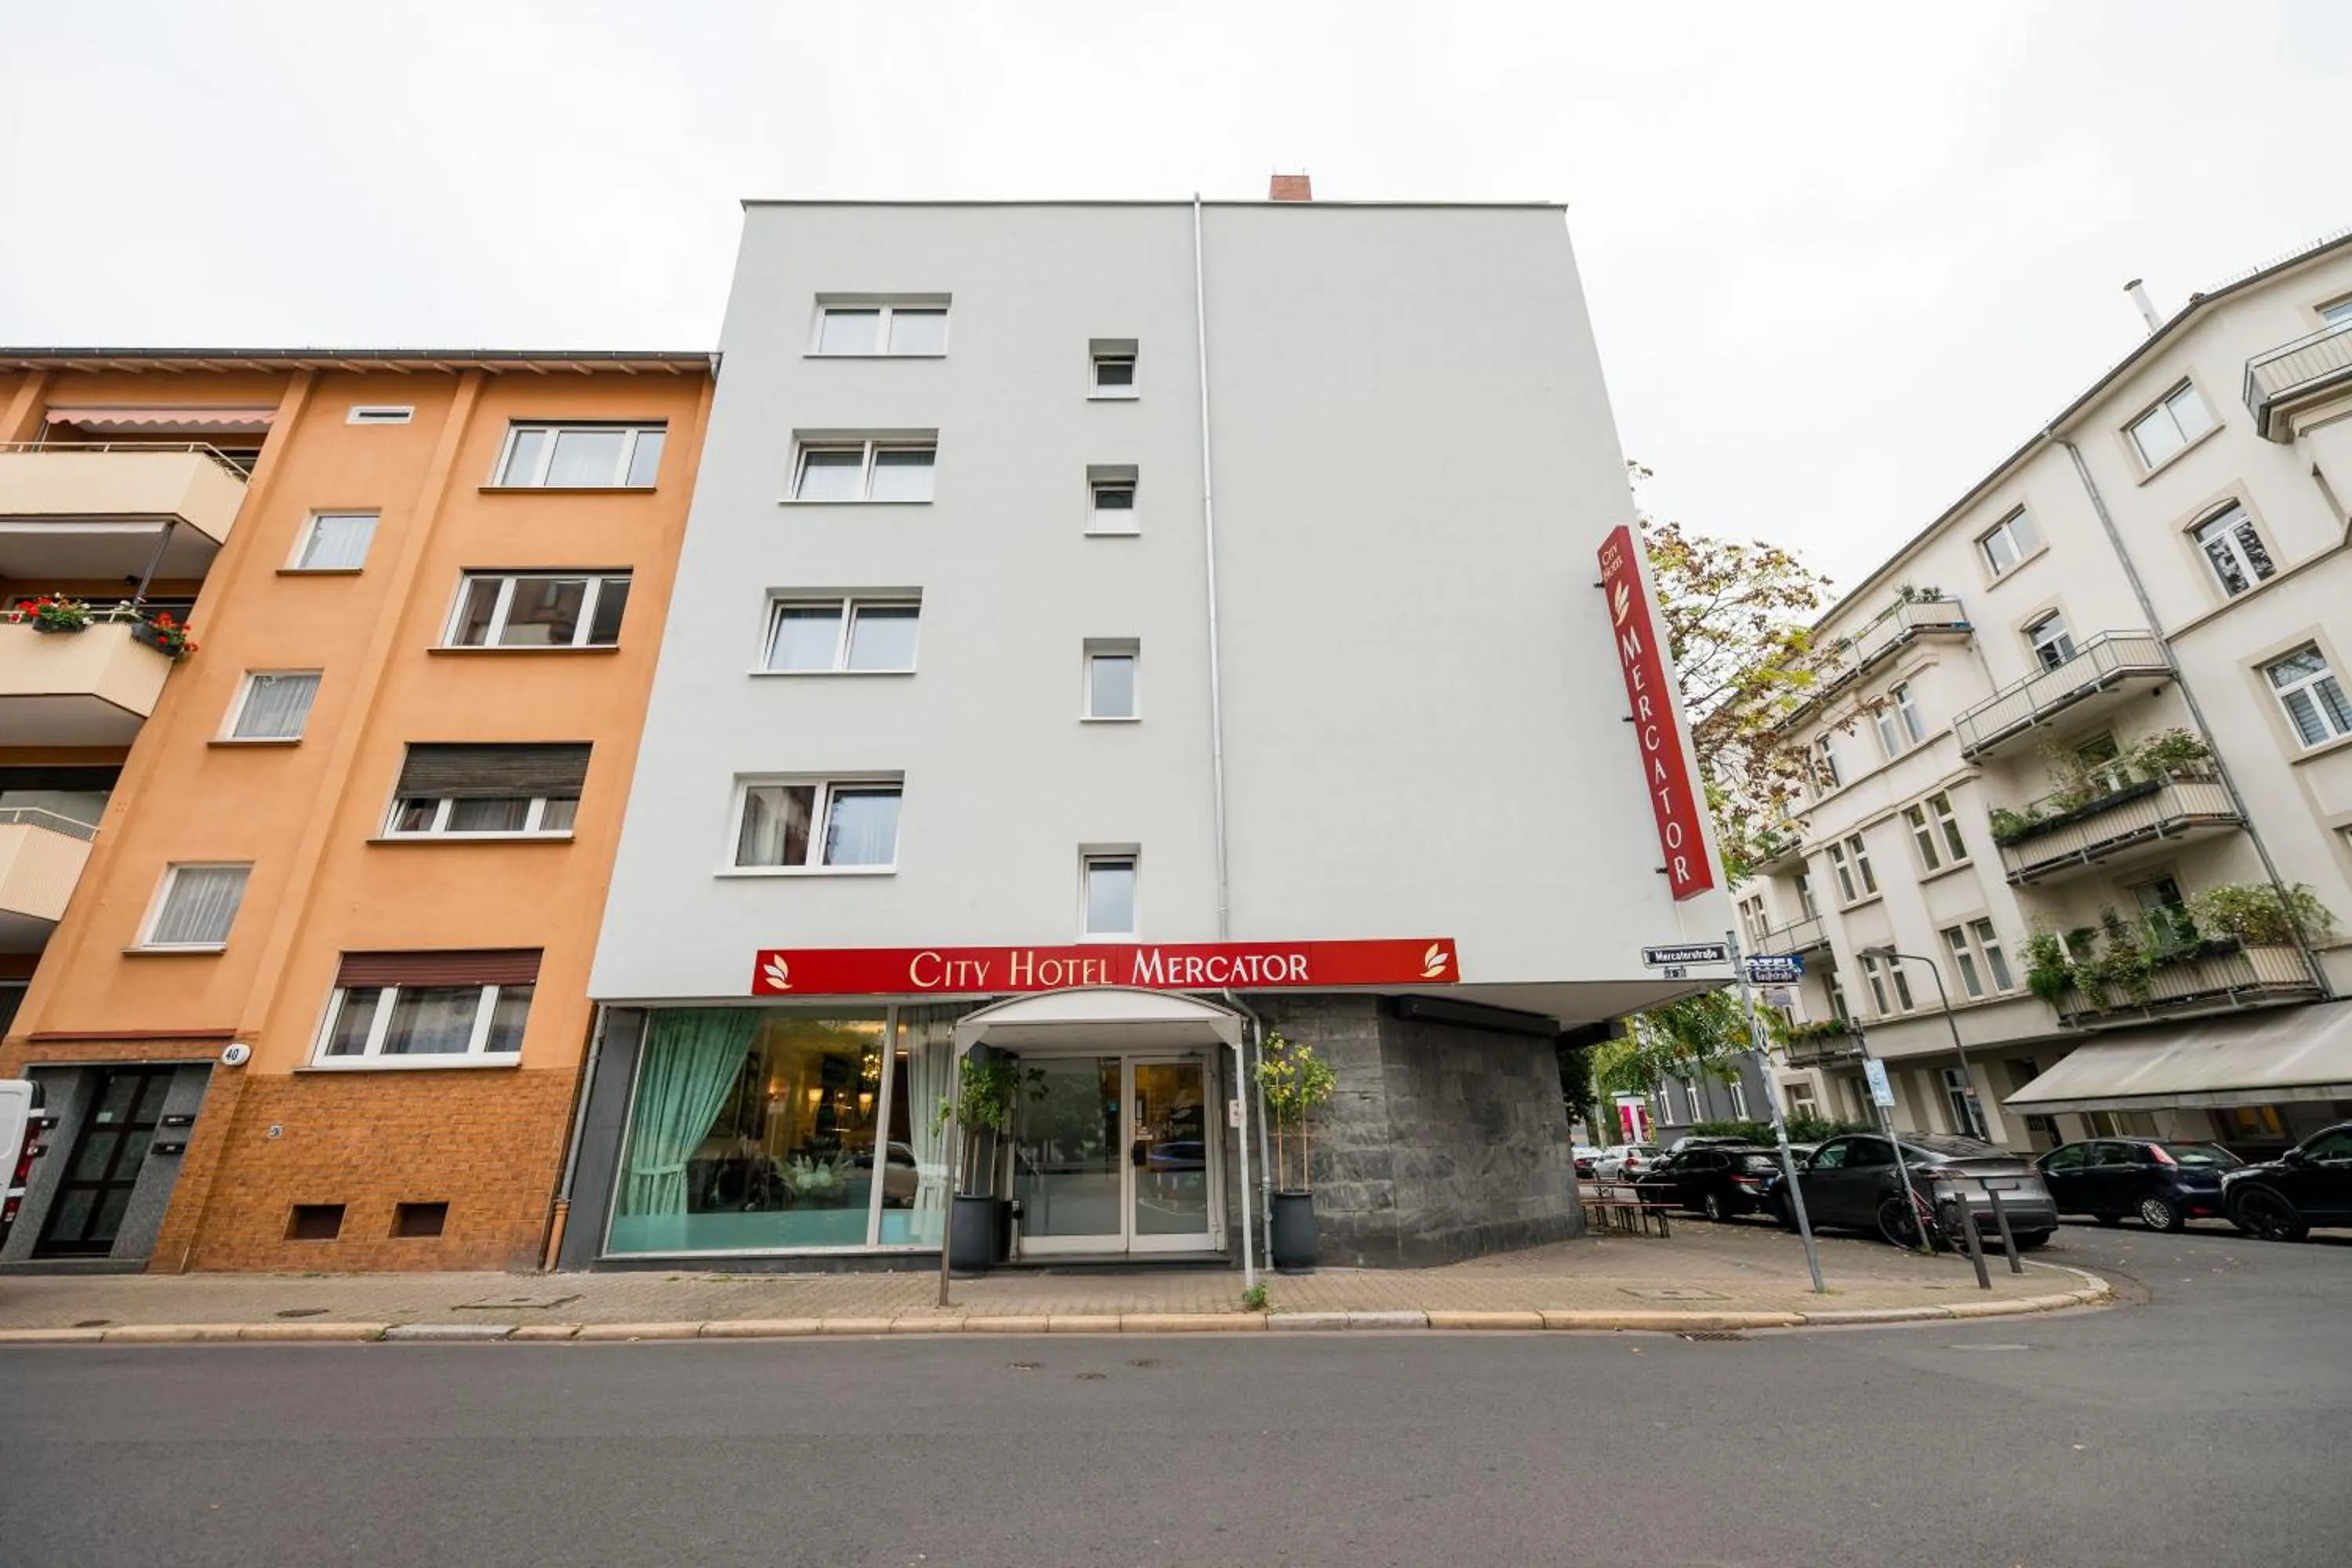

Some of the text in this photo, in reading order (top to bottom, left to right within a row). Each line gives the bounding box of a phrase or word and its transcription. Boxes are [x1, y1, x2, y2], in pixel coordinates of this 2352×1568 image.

[1622, 626, 1690, 885] MERCATOR
[1654, 947, 1719, 962] Mercatorstraße
[225, 1048, 240, 1061] 40
